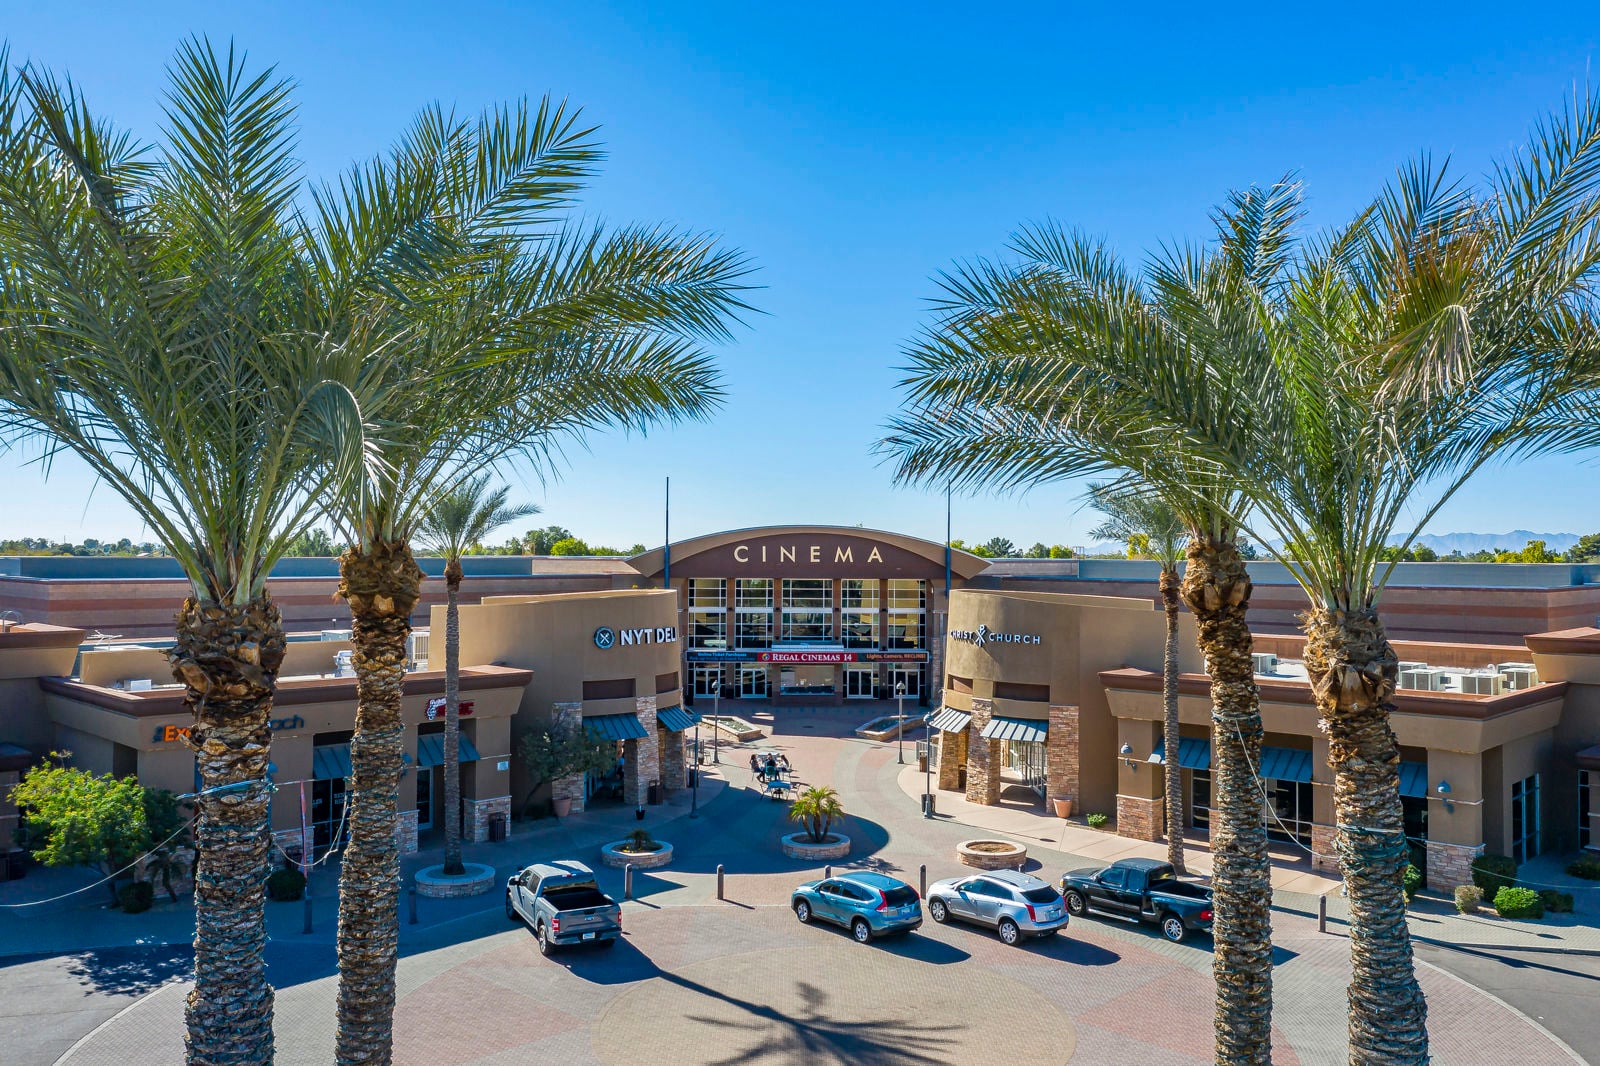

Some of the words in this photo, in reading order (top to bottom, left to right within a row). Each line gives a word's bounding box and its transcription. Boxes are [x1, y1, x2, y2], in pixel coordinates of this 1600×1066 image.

[733, 545, 884, 563] CINEMA
[620, 628, 653, 646] NYT
[950, 630, 973, 640] CHRIST
[988, 632, 1041, 645] CHURCH
[772, 653, 800, 661] REGAL
[801, 653, 841, 661] CINEMAS
[843, 653, 852, 661] 14
